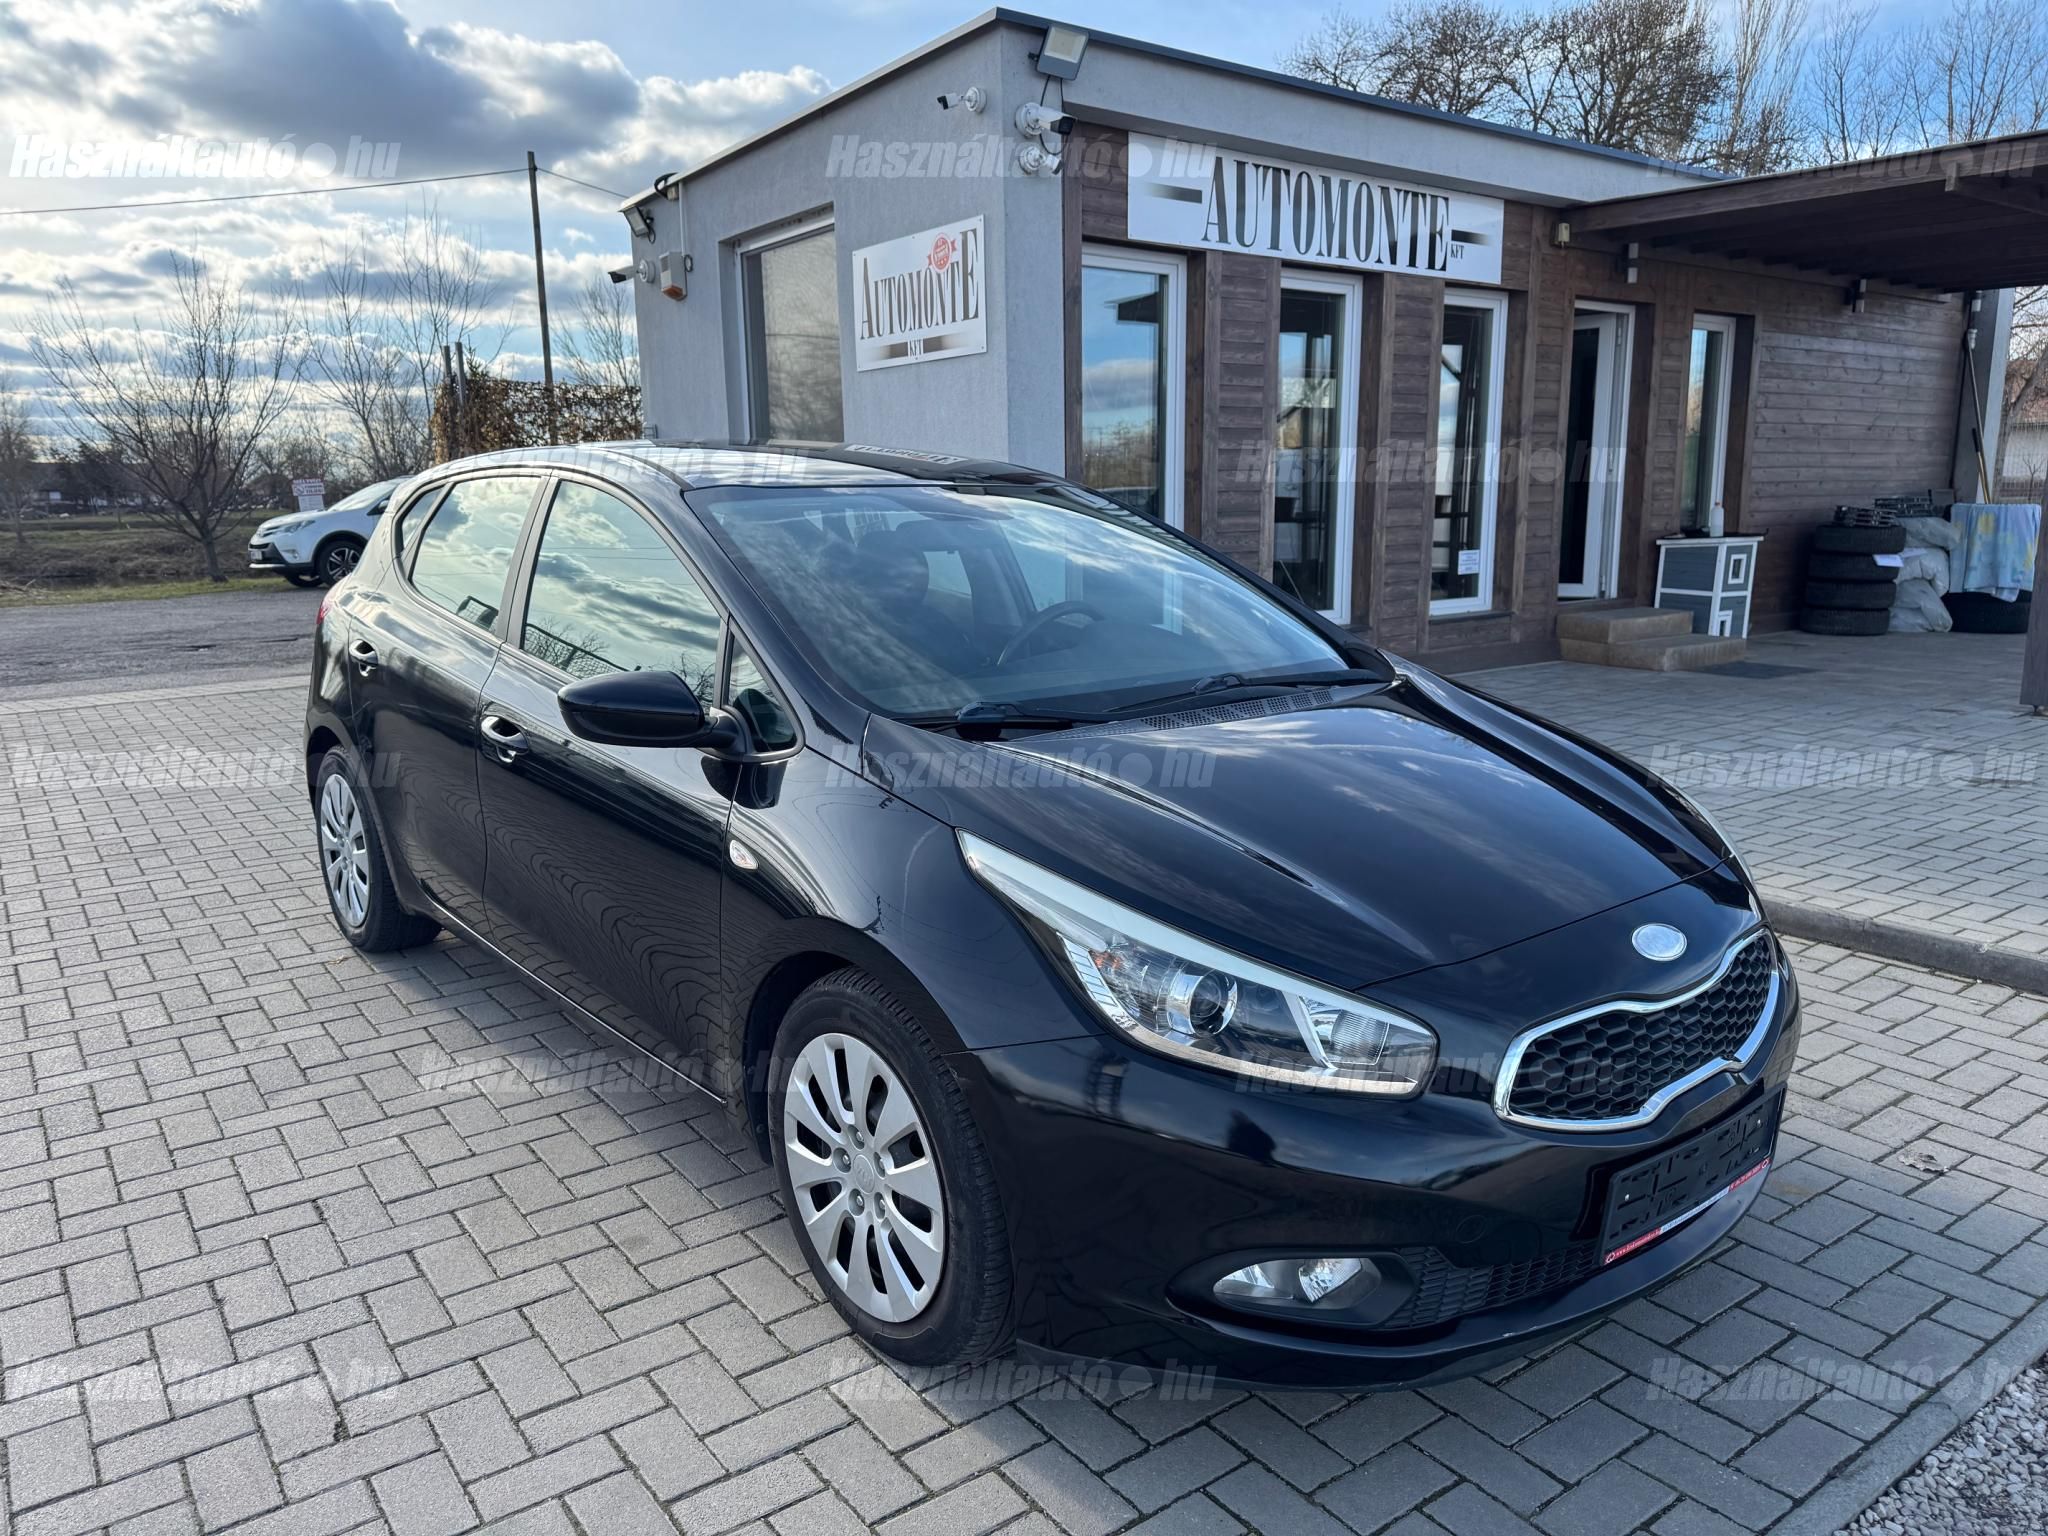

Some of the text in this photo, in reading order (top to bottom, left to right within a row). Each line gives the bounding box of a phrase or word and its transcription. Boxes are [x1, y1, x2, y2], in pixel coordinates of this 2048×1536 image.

[1202, 156, 1465, 271] AUTOMONTE KFT
[860, 228, 979, 340] AUTOMONTE
[909, 339, 922, 357] KFT
